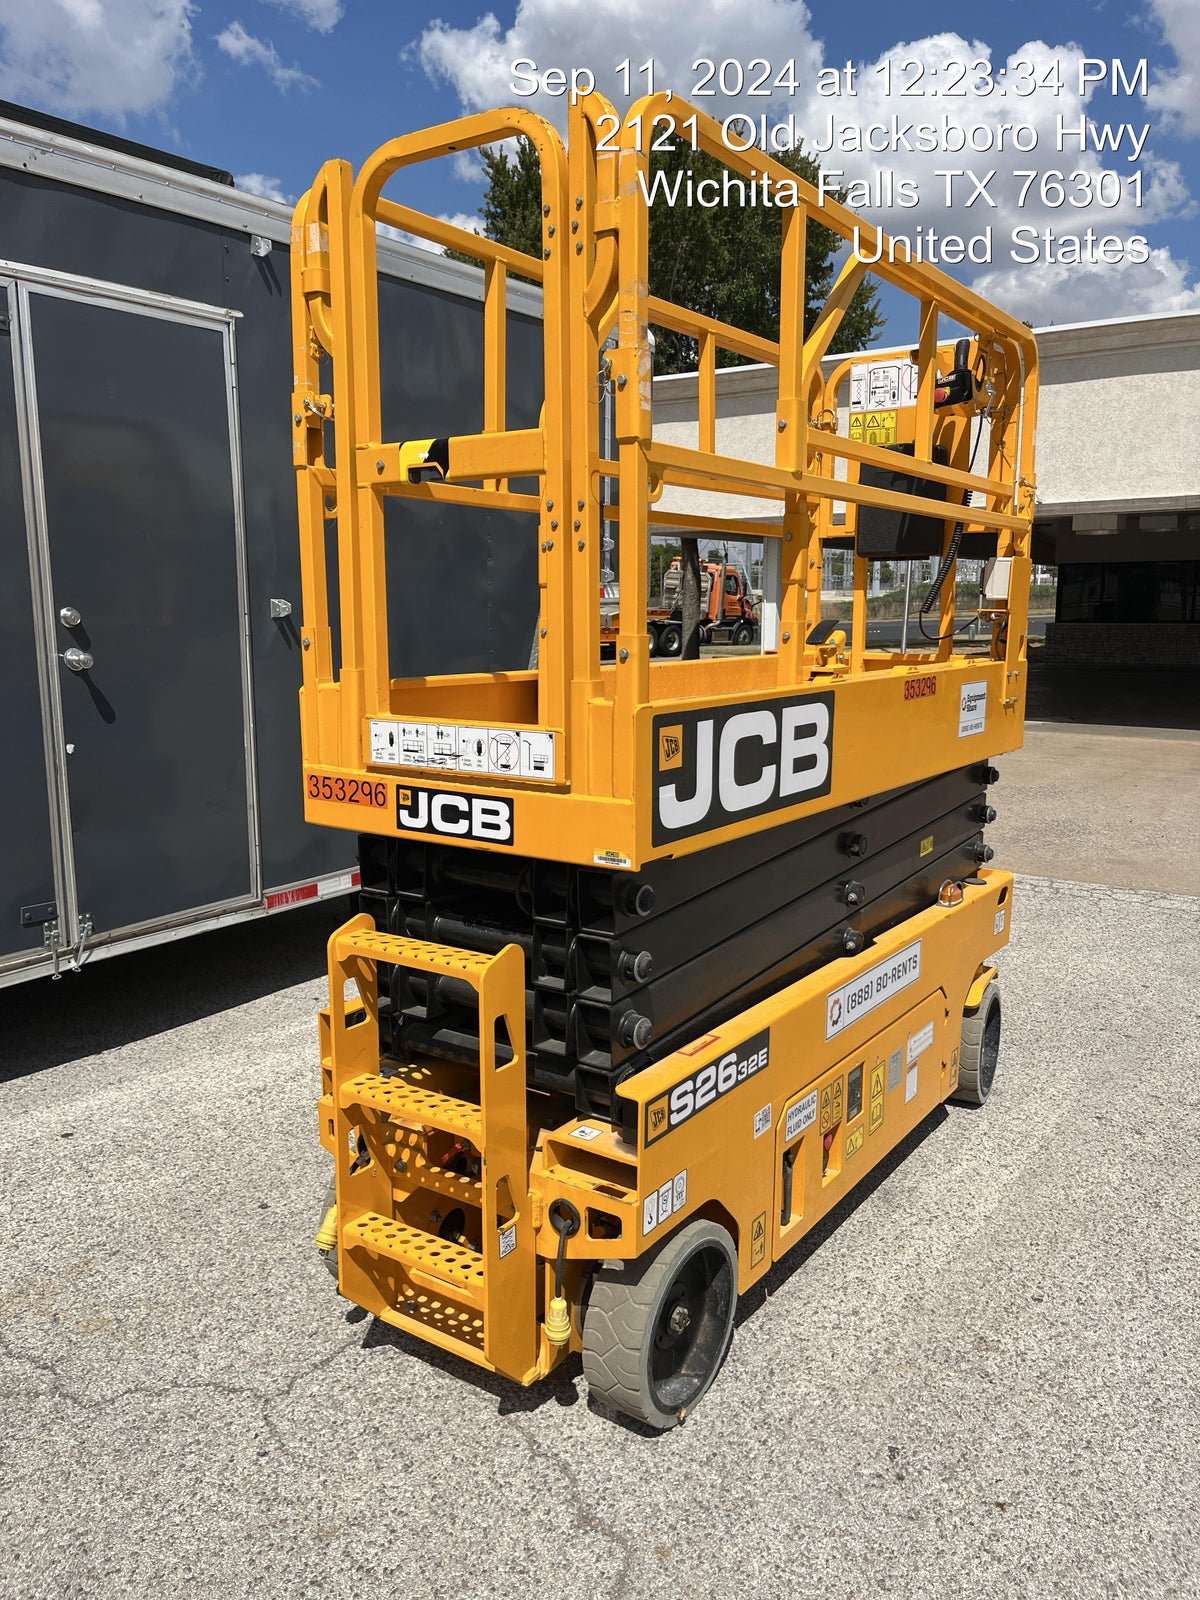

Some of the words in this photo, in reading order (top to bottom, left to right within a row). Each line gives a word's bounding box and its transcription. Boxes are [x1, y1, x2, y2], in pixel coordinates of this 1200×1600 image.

[904, 675, 937, 700] 353296
[664, 736, 680, 759] JCB
[659, 702, 829, 830] JCB
[309, 774, 386, 807] 353296
[399, 791, 511, 840] JCB
[846, 980, 874, 1014] (888)
[875, 953, 918, 993] 80-RENTS
[651, 1108, 665, 1129] JCB
[787, 1094, 816, 1123] HYDRAULIC
[787, 1118, 802, 1137] FLUID
[802, 1108, 816, 1125] ONLY
